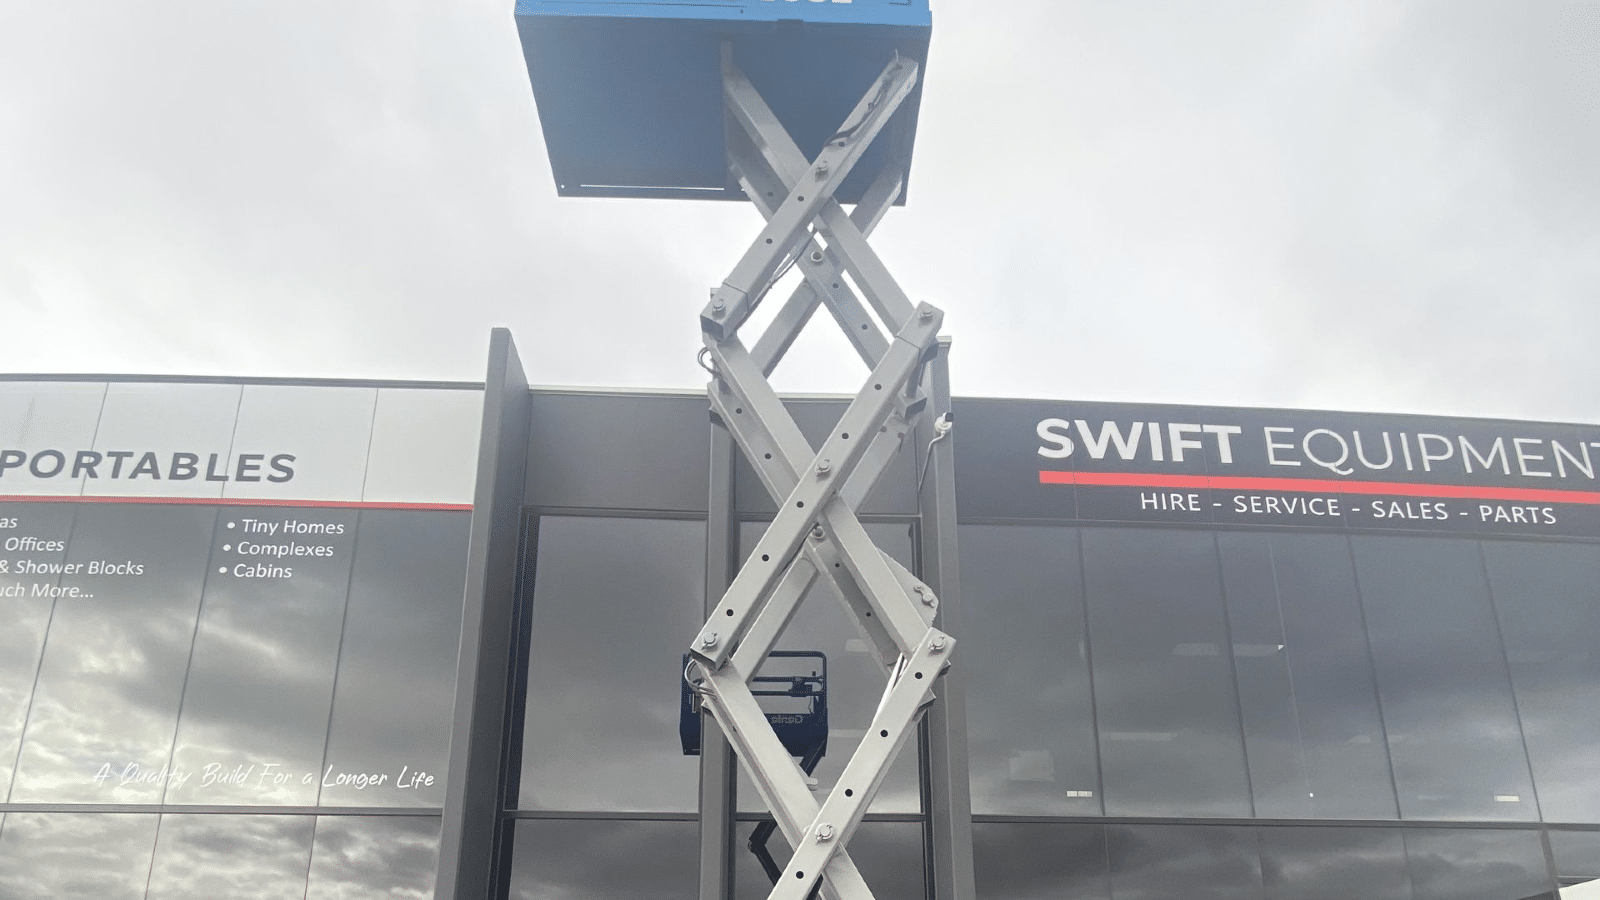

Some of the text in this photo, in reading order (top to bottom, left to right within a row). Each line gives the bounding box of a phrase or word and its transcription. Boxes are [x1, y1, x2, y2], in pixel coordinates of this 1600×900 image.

[1036, 418, 1600, 479] SWIFT EQUIPMEN
[0, 449, 297, 483] PORTABLES
[1140, 492, 1201, 511] HIRE
[1233, 495, 1341, 516] SERVICE
[1372, 500, 1449, 520] SALES
[1479, 505, 1556, 524] PARTS
[242, 519, 345, 536] Tiny Homes
[4, 536, 65, 551] Offices
[237, 541, 334, 558] Complexes
[0, 559, 145, 575] & Shower Blocks
[233, 563, 293, 578] Cabins
[30, 583, 94, 598] More...
[92, 762, 435, 790] A Quality Build For a Longer Life
